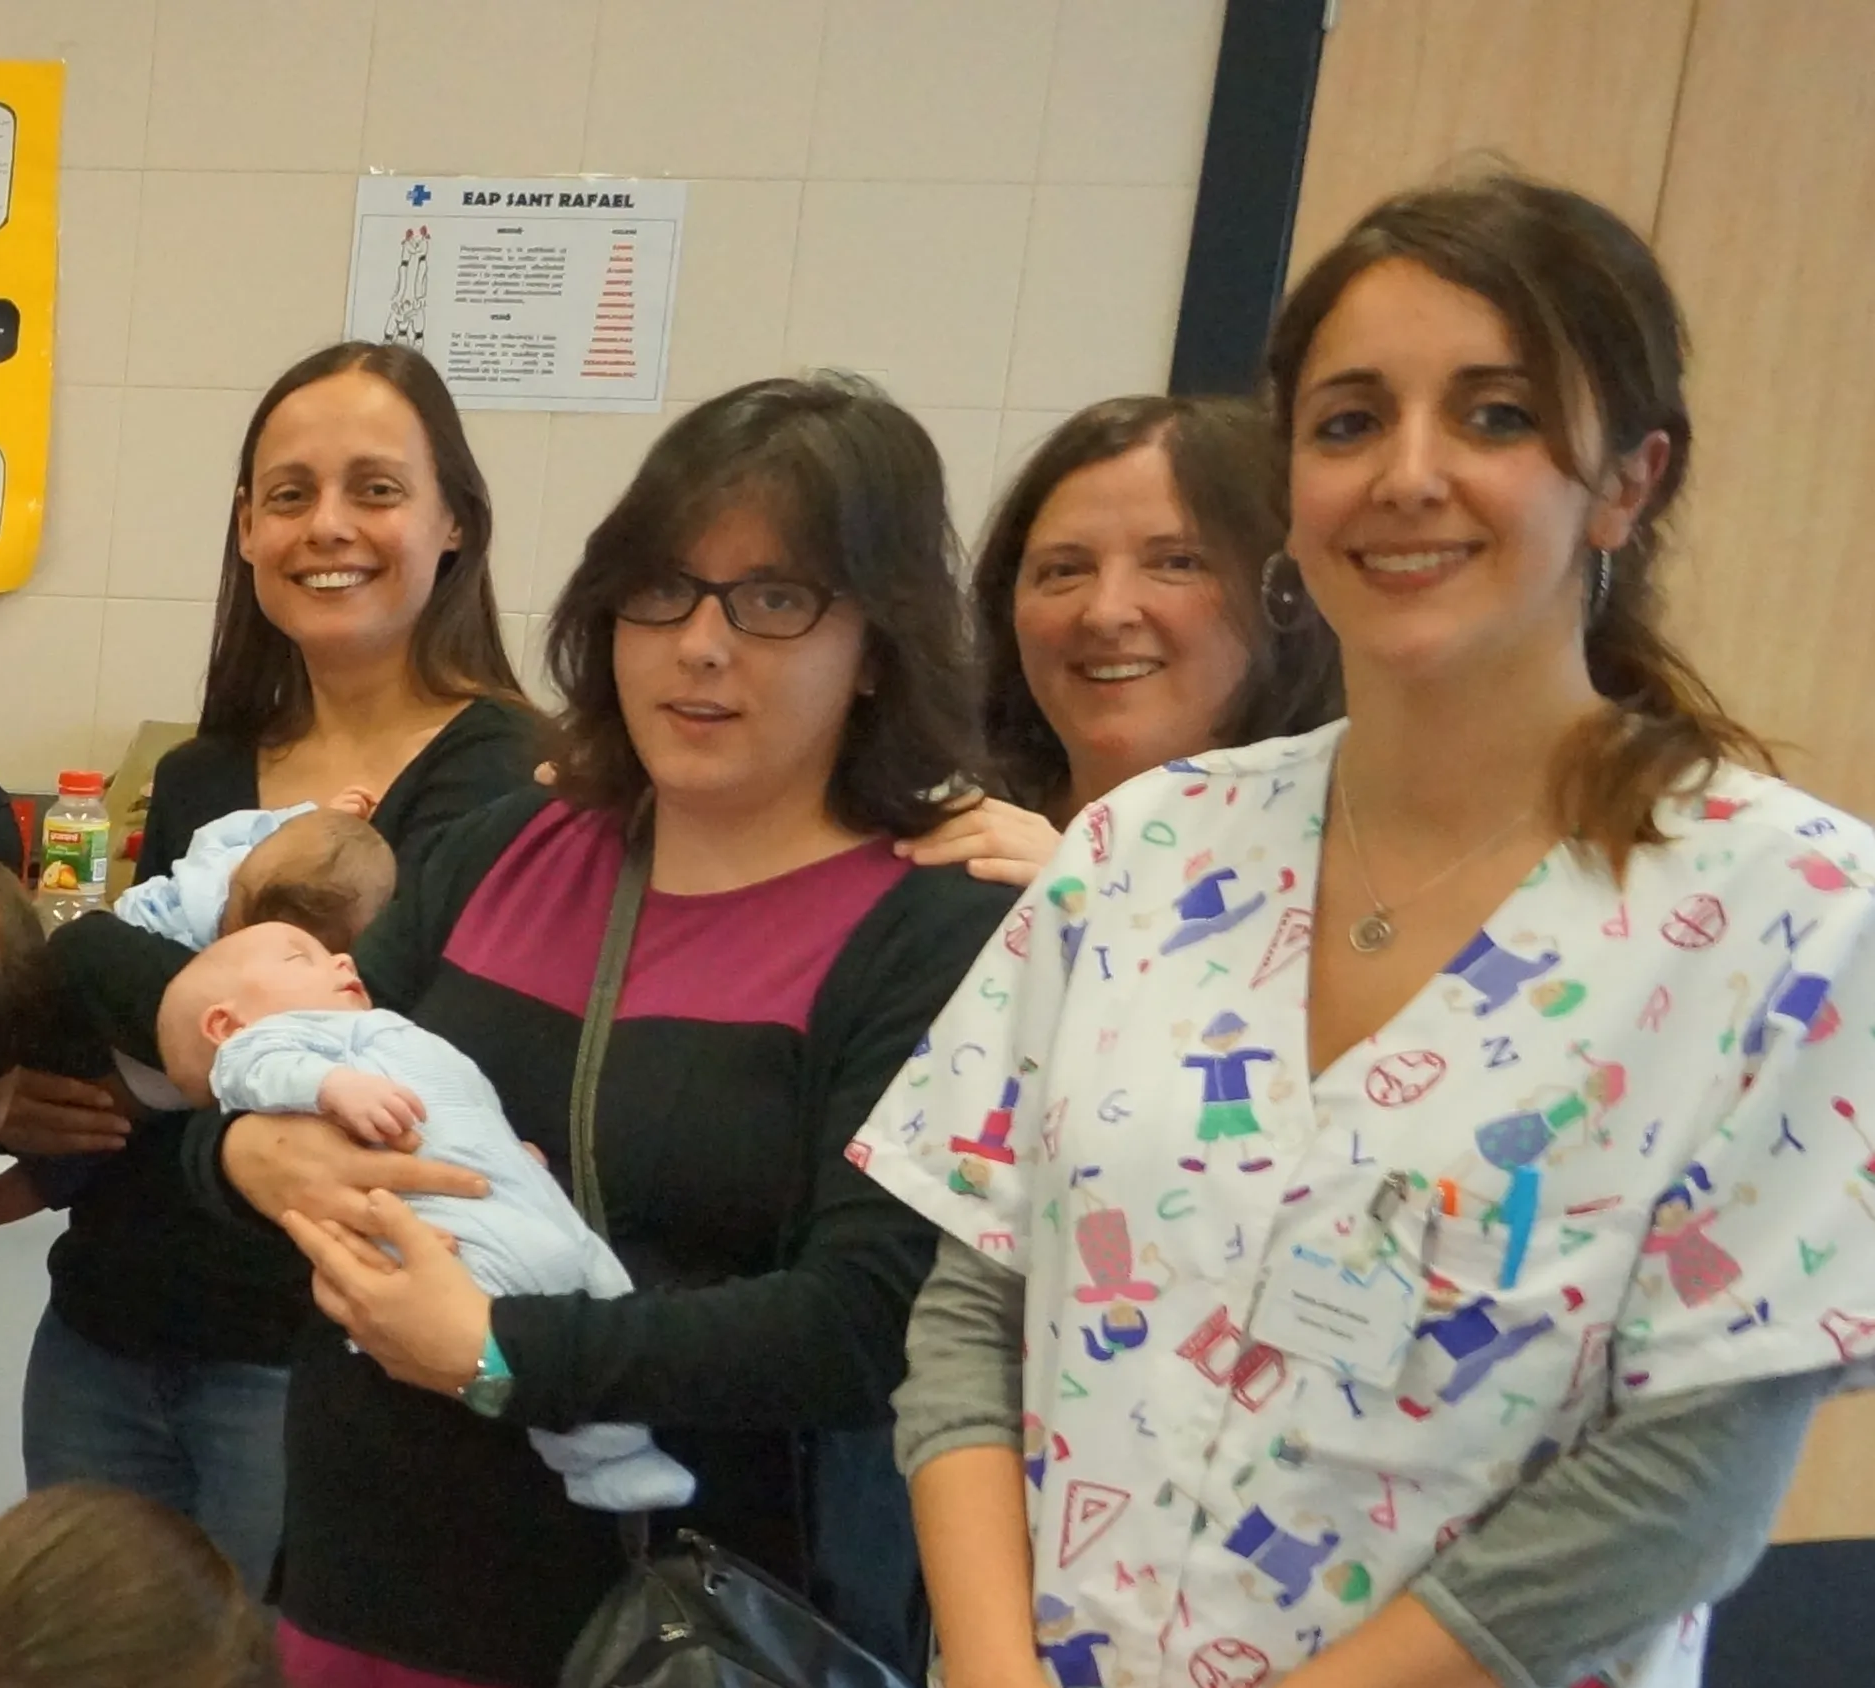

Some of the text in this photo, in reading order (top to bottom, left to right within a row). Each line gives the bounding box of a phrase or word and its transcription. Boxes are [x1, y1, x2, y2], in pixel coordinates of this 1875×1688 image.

[462, 191, 636, 209] EAP SANT RAFAEL
